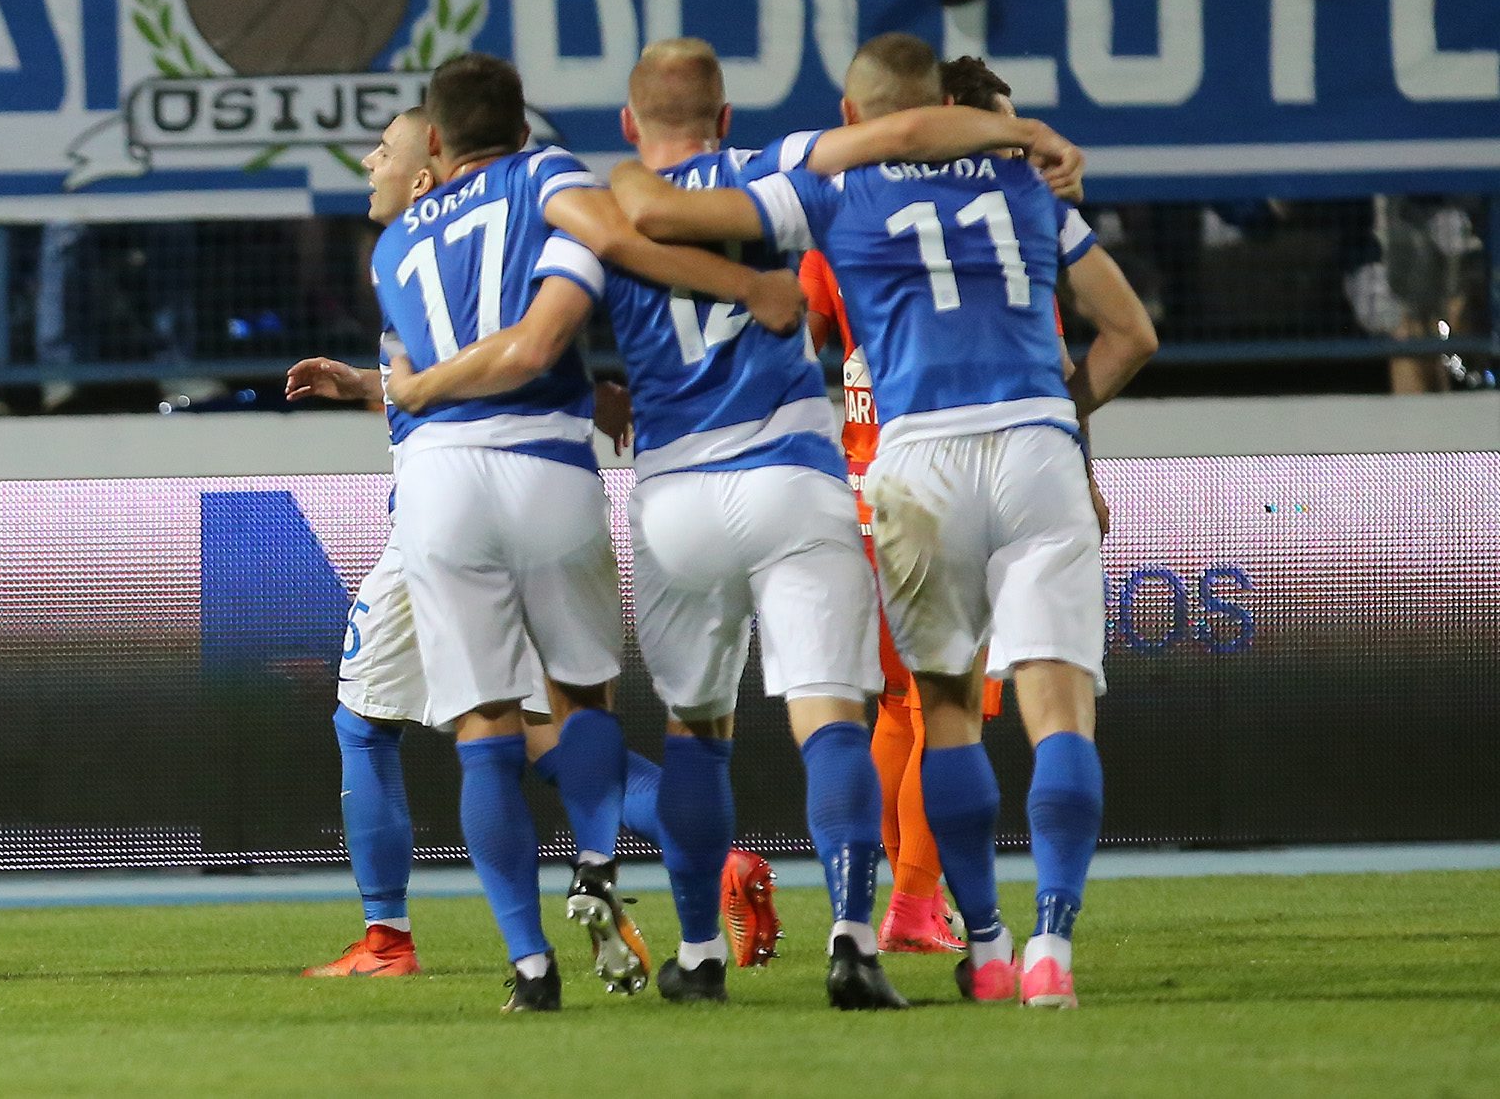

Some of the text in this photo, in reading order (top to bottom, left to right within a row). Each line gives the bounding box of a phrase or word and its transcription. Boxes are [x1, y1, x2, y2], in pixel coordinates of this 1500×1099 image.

[152, 83, 428, 133] OSIJE
[396, 197, 509, 362] 17
[886, 190, 1031, 312] 11
